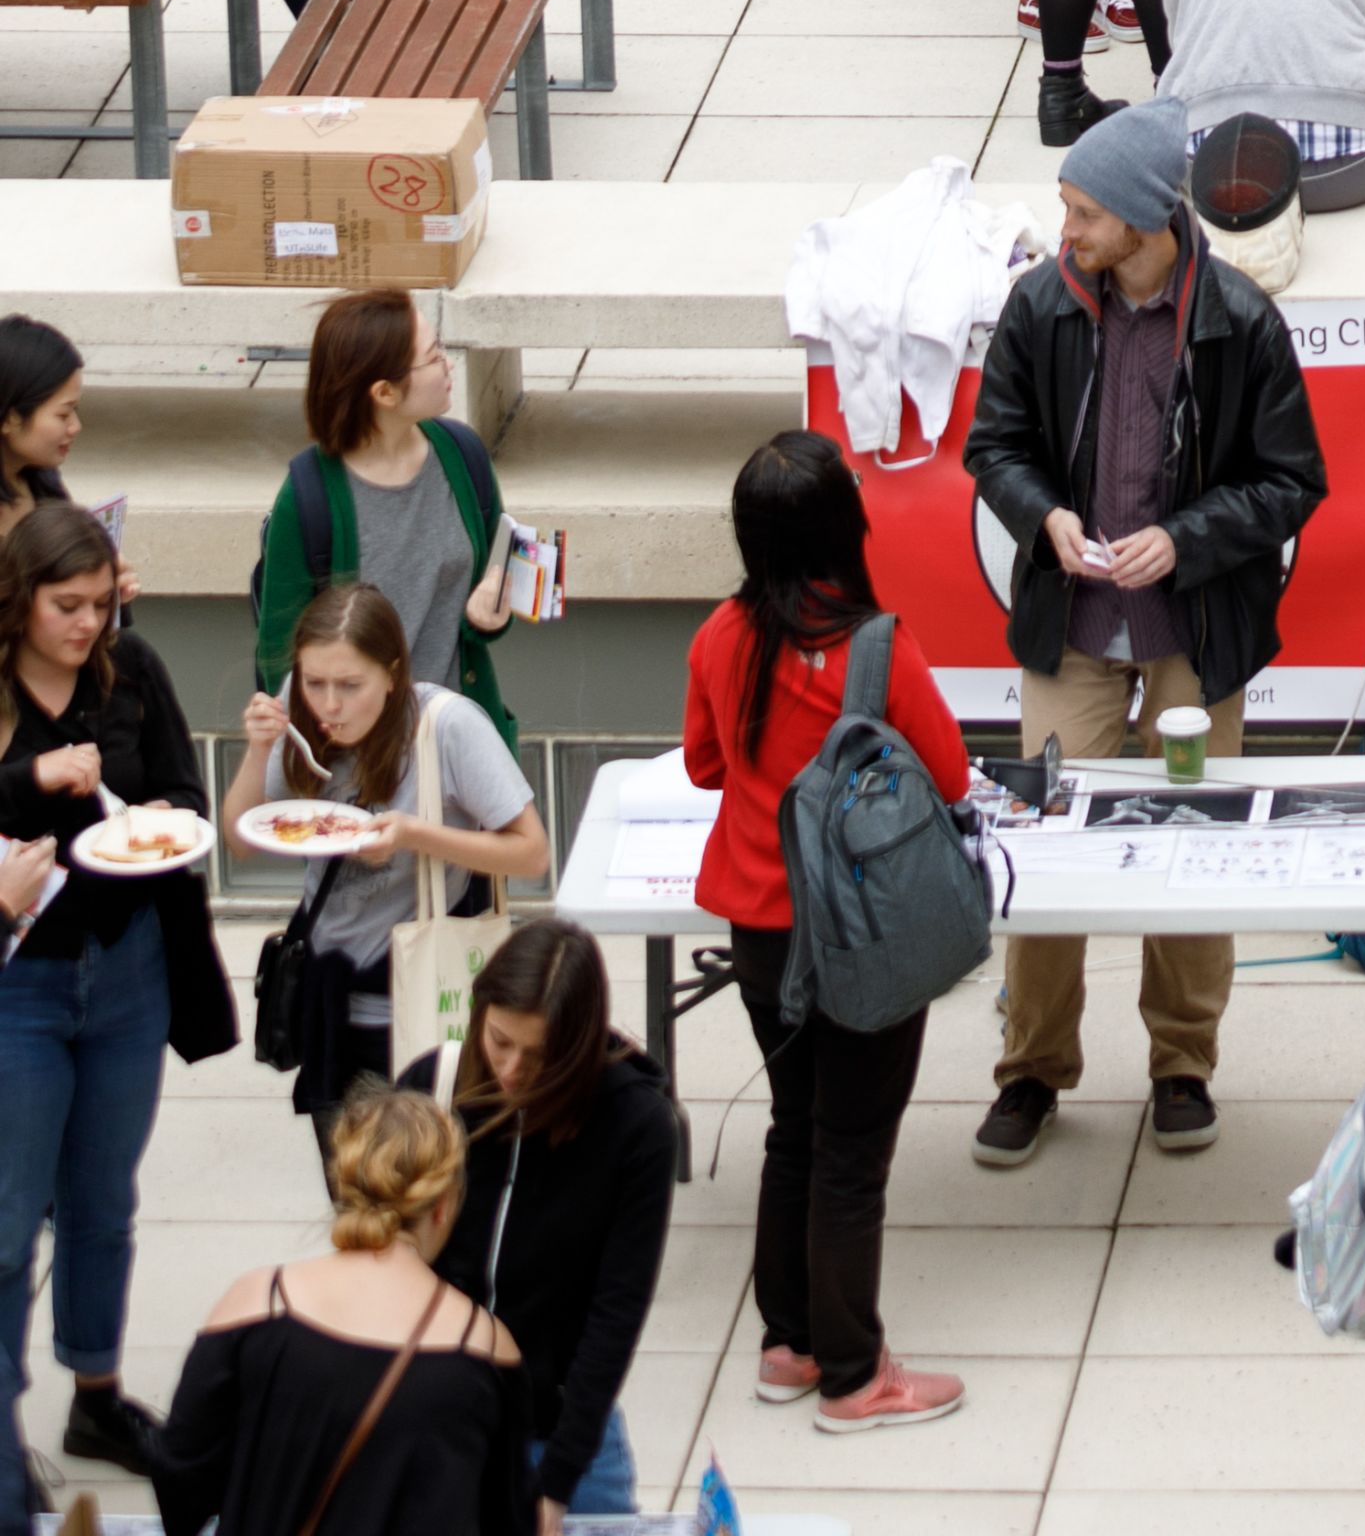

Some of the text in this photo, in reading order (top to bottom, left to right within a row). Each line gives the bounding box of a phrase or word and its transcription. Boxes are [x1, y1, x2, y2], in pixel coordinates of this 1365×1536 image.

[379, 165, 427, 206] 28
[262, 170, 278, 281] TRENDS COLLECTION
[1288, 324, 1328, 354] ng
